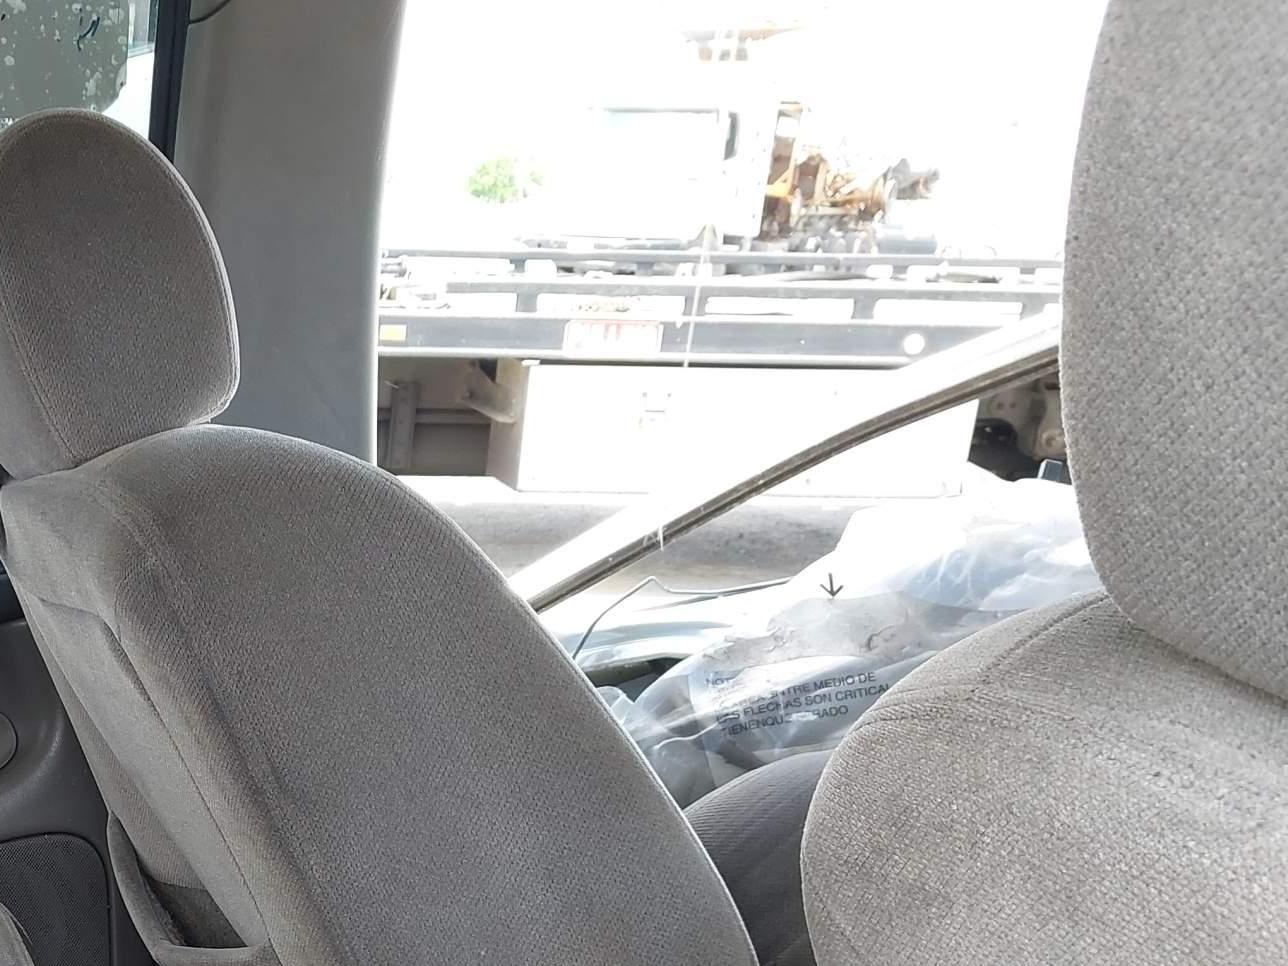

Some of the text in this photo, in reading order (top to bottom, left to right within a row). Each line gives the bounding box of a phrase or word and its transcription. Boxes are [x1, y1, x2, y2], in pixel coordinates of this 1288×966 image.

[814, 674, 855, 691] MEDIO
[858, 671, 876, 684] DE
[743, 697, 802, 717] FLECHAS
[804, 692, 832, 706] SON
